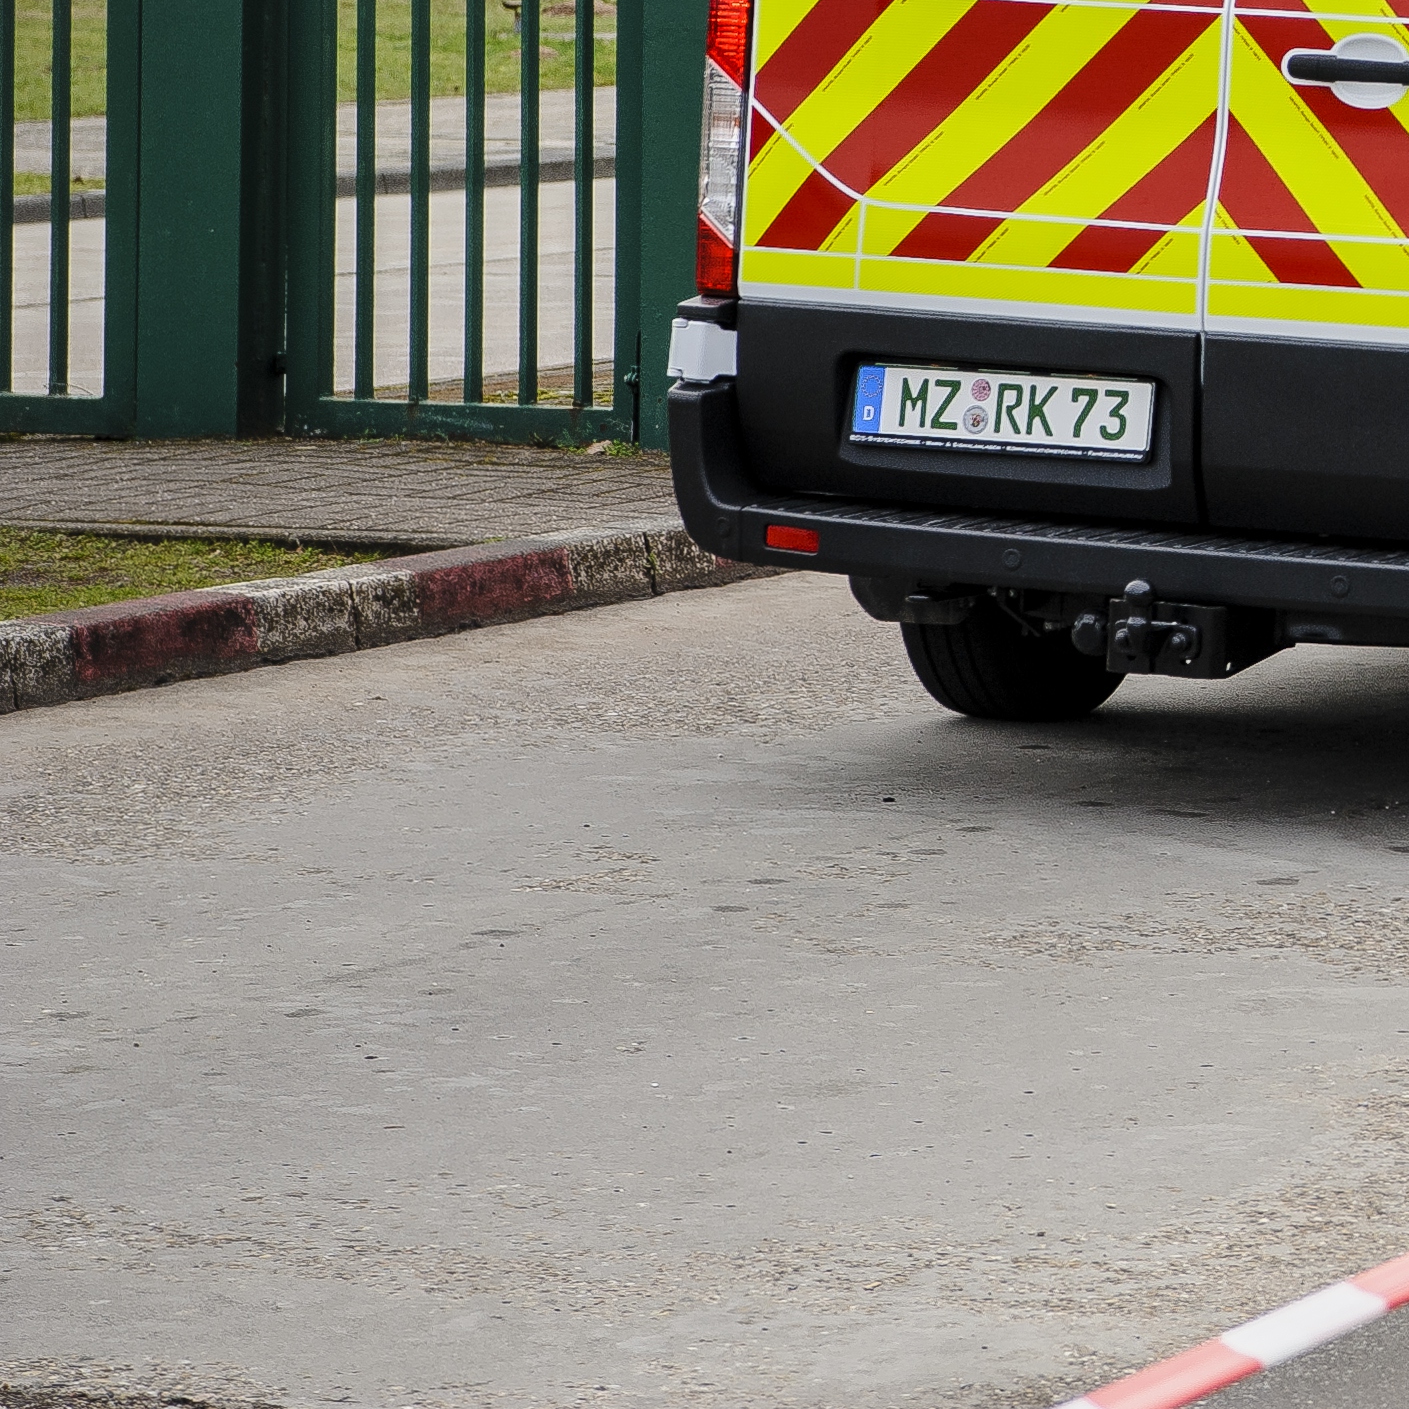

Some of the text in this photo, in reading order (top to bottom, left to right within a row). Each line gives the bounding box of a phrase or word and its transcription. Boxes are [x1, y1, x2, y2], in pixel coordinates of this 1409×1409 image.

[862, 404, 875, 421] D
[898, 376, 1130, 441] MZ RK 73
